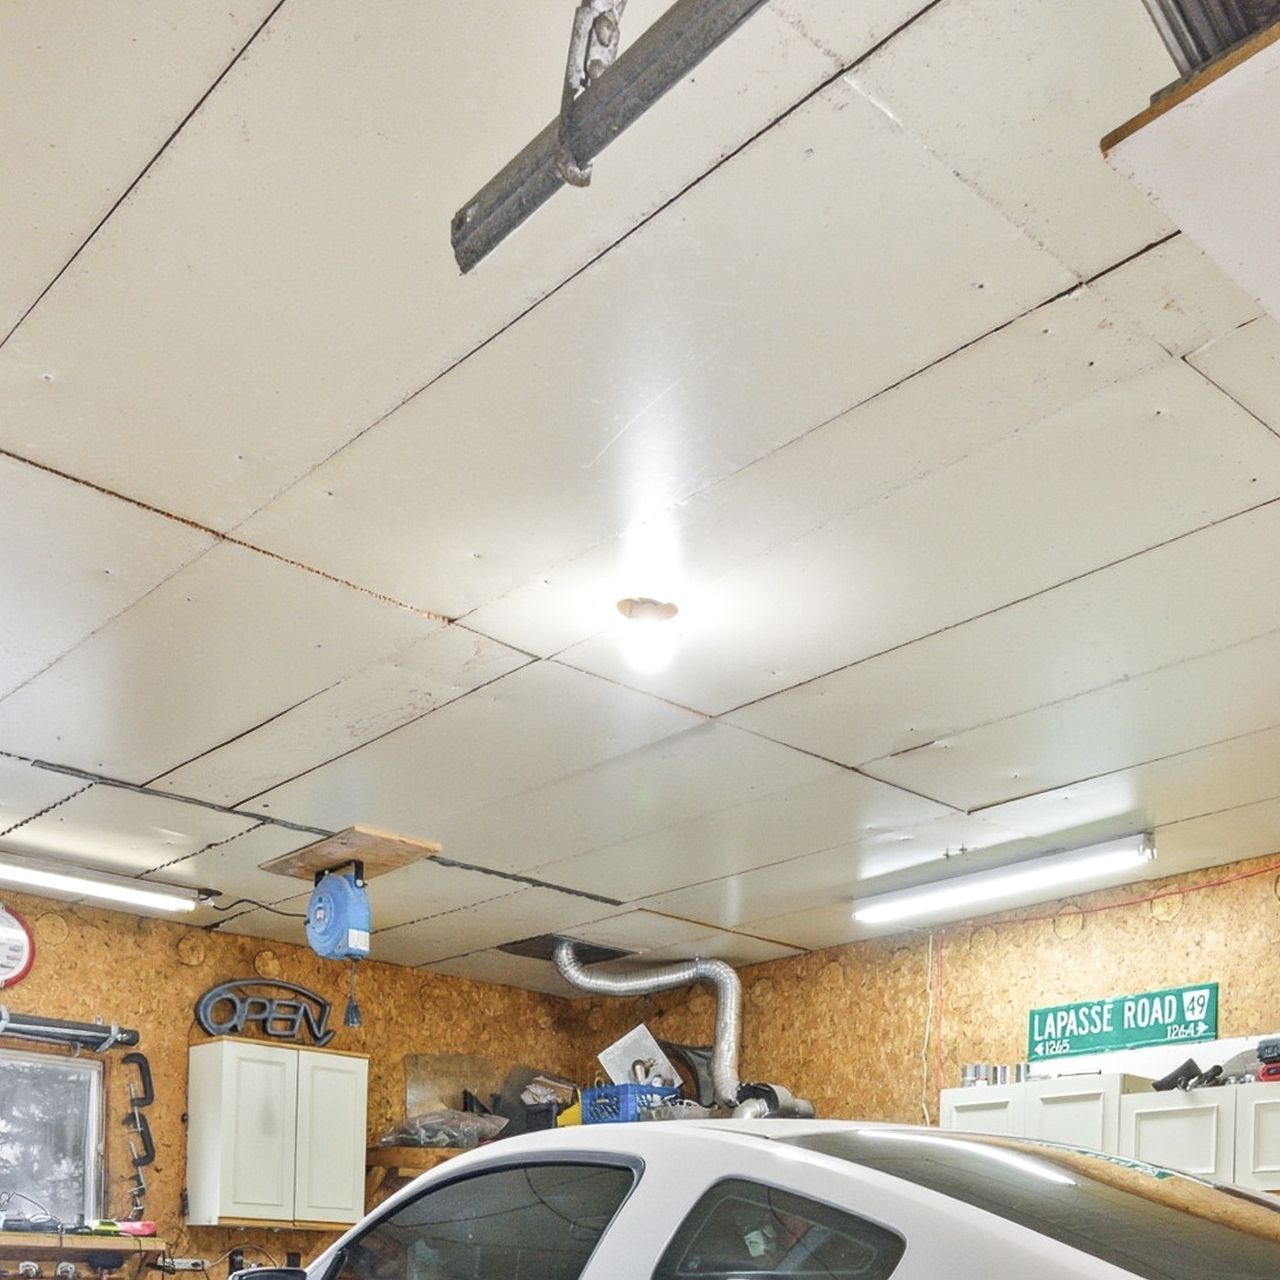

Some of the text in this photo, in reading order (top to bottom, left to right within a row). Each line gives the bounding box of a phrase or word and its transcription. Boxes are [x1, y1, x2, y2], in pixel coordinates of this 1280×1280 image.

[200, 985, 333, 1045] OPEN
[1033, 994, 1207, 1041] LAPASSE ROAD 49
[1045, 1040, 1070, 1056] 1265
[1166, 1024, 1197, 1041] 1264
